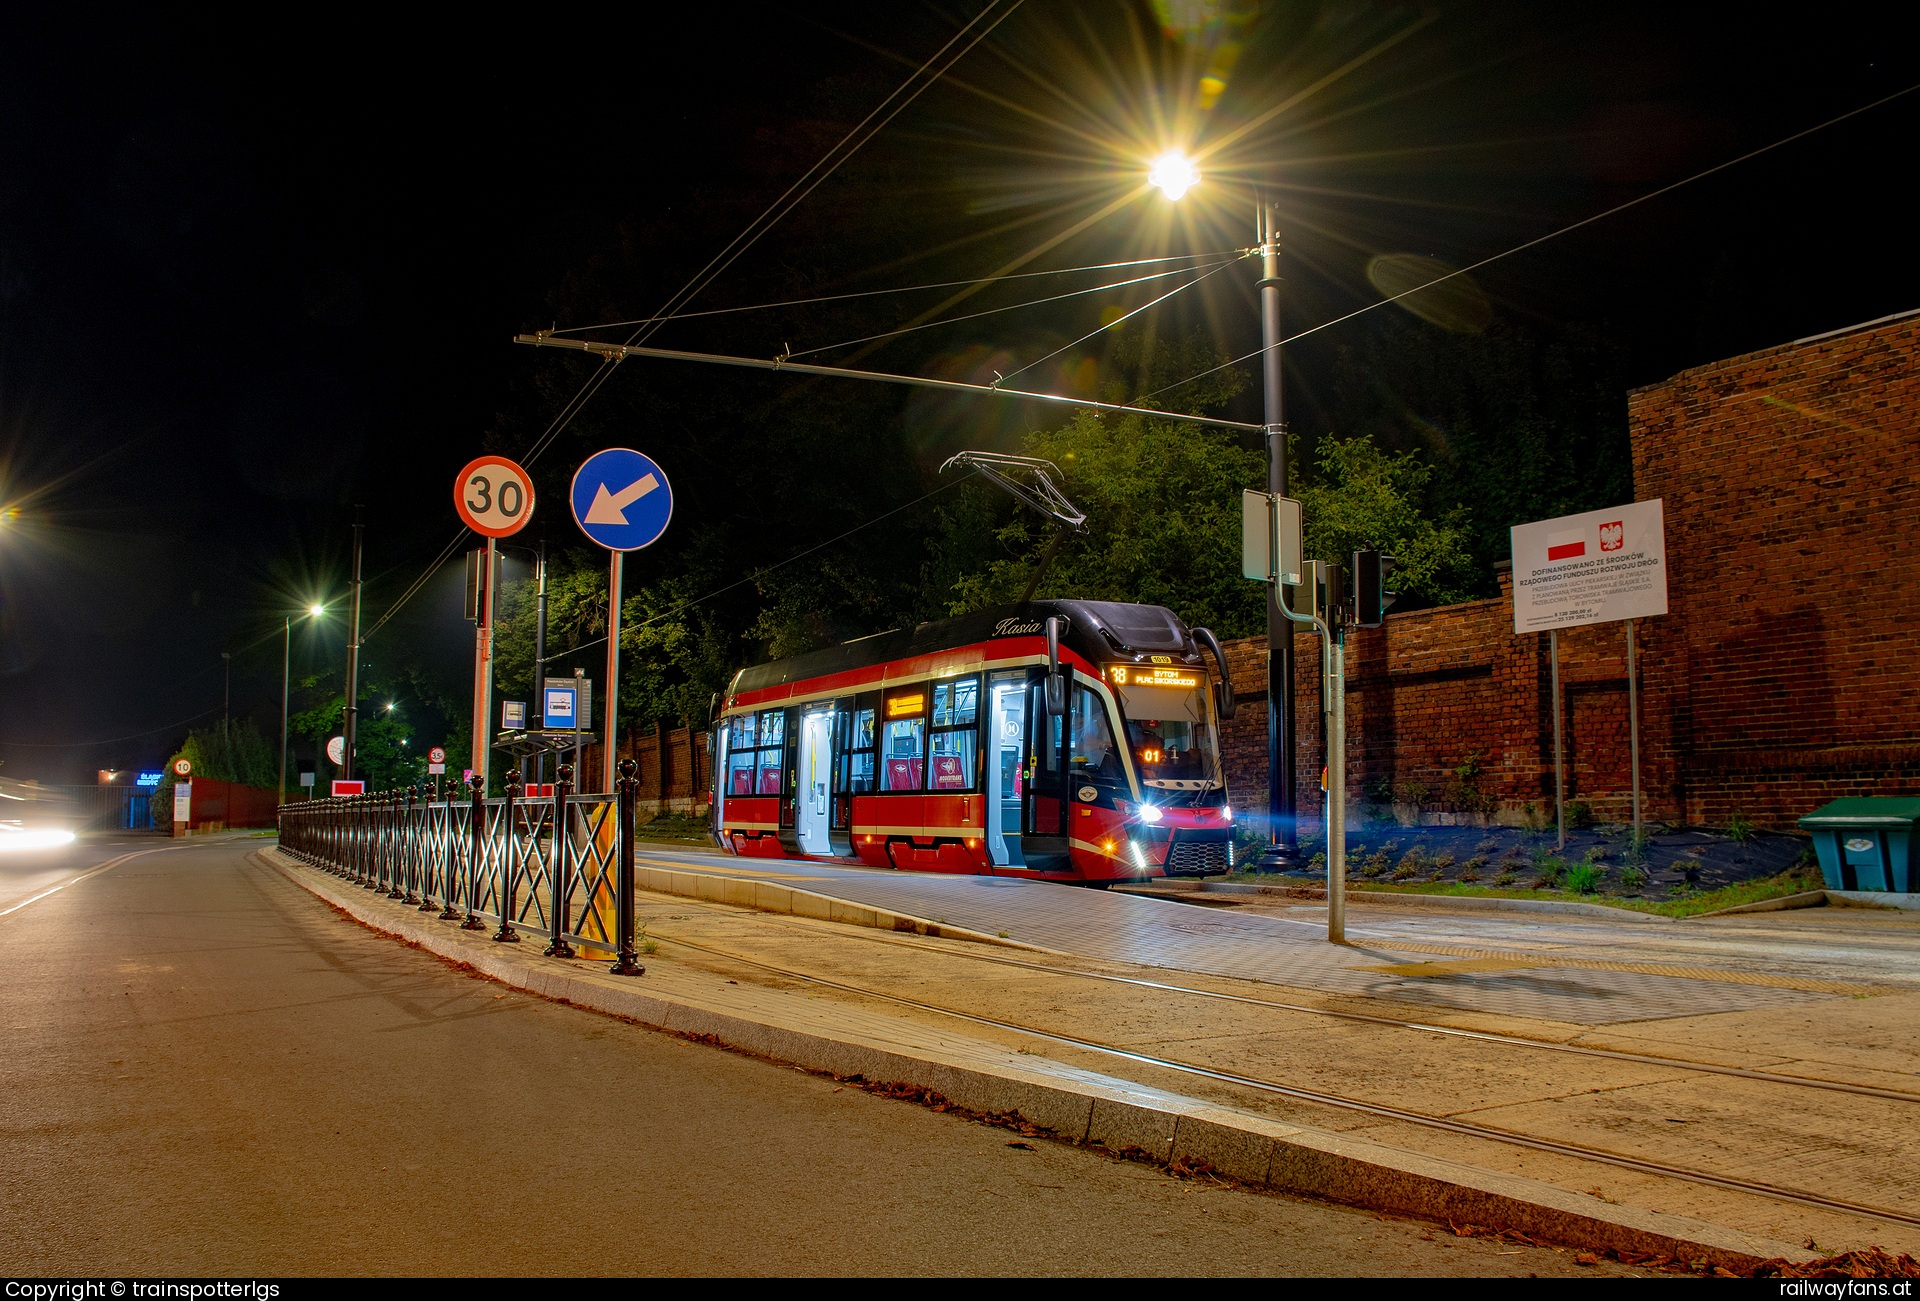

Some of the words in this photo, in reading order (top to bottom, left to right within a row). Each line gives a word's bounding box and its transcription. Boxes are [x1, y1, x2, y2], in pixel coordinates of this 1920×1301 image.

[467, 475, 523, 517] 30
[1519, 574, 1562, 586] RZĄDOWEGO
[1563, 568, 1599, 579] FUNDUSZU
[1600, 562, 1636, 573] ROZWOJU
[1637, 557, 1659, 568] DRÓG
[1532, 560, 1595, 576] DOFINANSOWANO
[1596, 558, 1605, 566] ZE
[1606, 552, 1645, 564] ŚRODKÓW
[1532, 583, 1568, 593] PRZEBUDOWA
[1569, 579, 1584, 587] ULICY
[1585, 574, 1618, 584] PIEKARSKIEJ
[1625, 569, 1651, 578] ZWIĄZKU
[1536, 589, 1570, 599] PLANOWANĄ
[1587, 581, 1618, 591] TRAMWAJE
[1618, 577, 1640, 587] ŚLĄSKIE
[1532, 597, 1568, 607] PRZEBUDOWĄ
[1568, 591, 1601, 600] TOROWISKA
[1602, 583, 1653, 595] TRAMWAJOWEGO
[991, 617, 1043, 637] Kasia
[1111, 667, 1126, 683] 38
[1136, 676, 1154, 684] PLAC
[1154, 670, 1179, 678] BYTOM
[1145, 750, 1160, 761] 01
[178, 763, 189, 772] 10
